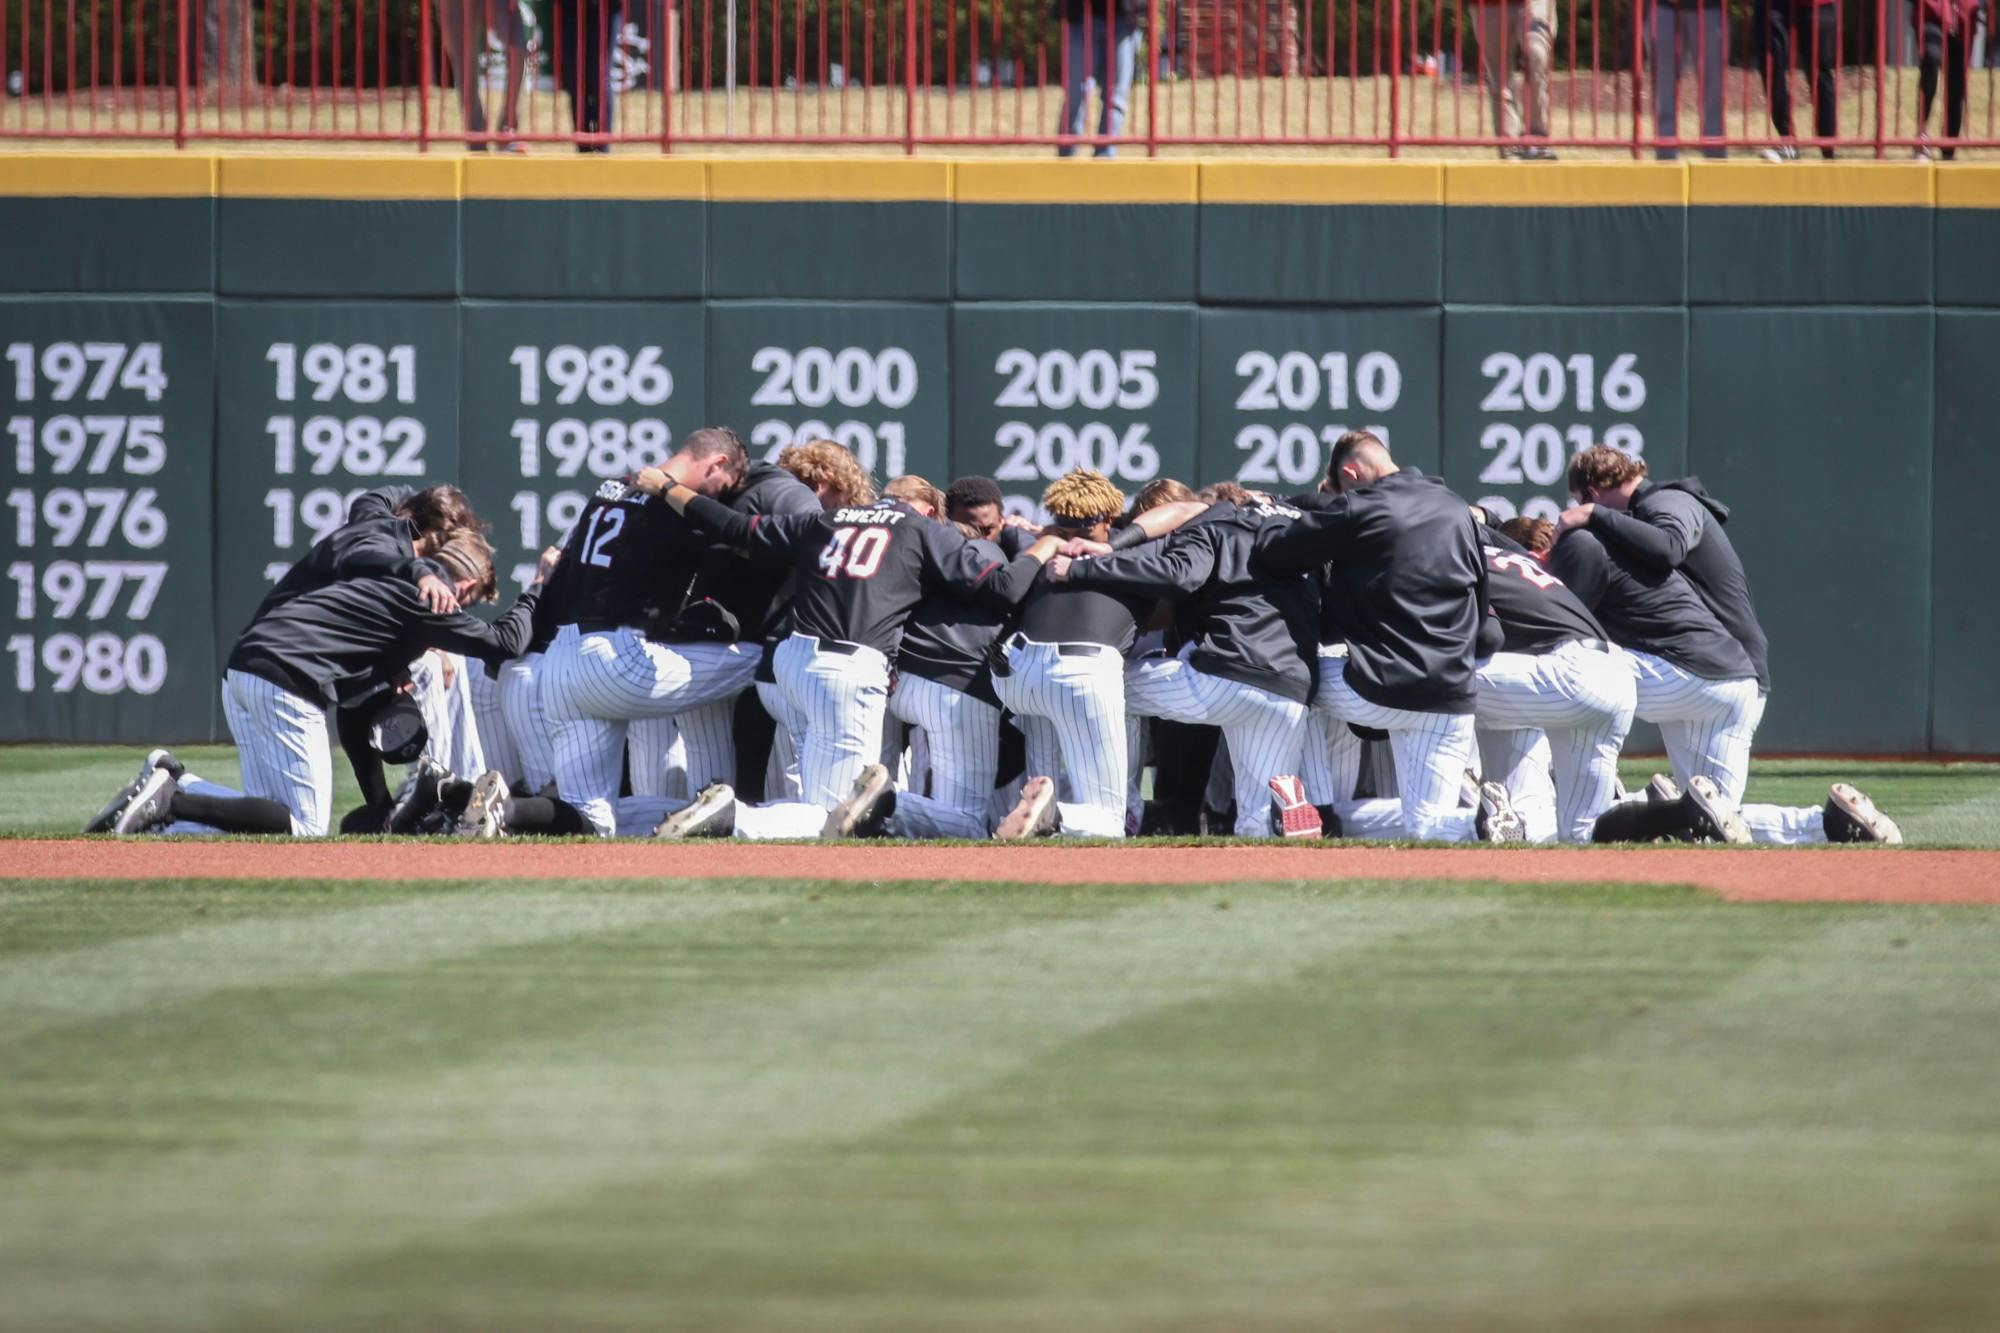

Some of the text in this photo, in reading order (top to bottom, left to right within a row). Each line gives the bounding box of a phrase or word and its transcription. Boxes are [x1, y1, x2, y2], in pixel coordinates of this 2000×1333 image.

[6, 342, 168, 401] 1974
[266, 342, 416, 403] 1981
[510, 345, 674, 405] 1986
[751, 346, 918, 408] 2000
[994, 348, 1159, 409] 2005
[1235, 350, 1401, 411] 2010
[1480, 352, 1647, 412] 2016
[7, 415, 167, 475] 1975
[265, 416, 426, 476] 1982
[510, 418, 672, 479] 1988
[994, 421, 1160, 481] 2006
[1234, 422, 1391, 485] 20
[6, 488, 167, 548] 1976
[580, 505, 625, 568] 12
[833, 508, 906, 525] SWEATT
[818, 525, 892, 578] 40
[7, 560, 169, 620] 1977
[6, 633, 168, 694] 1980
